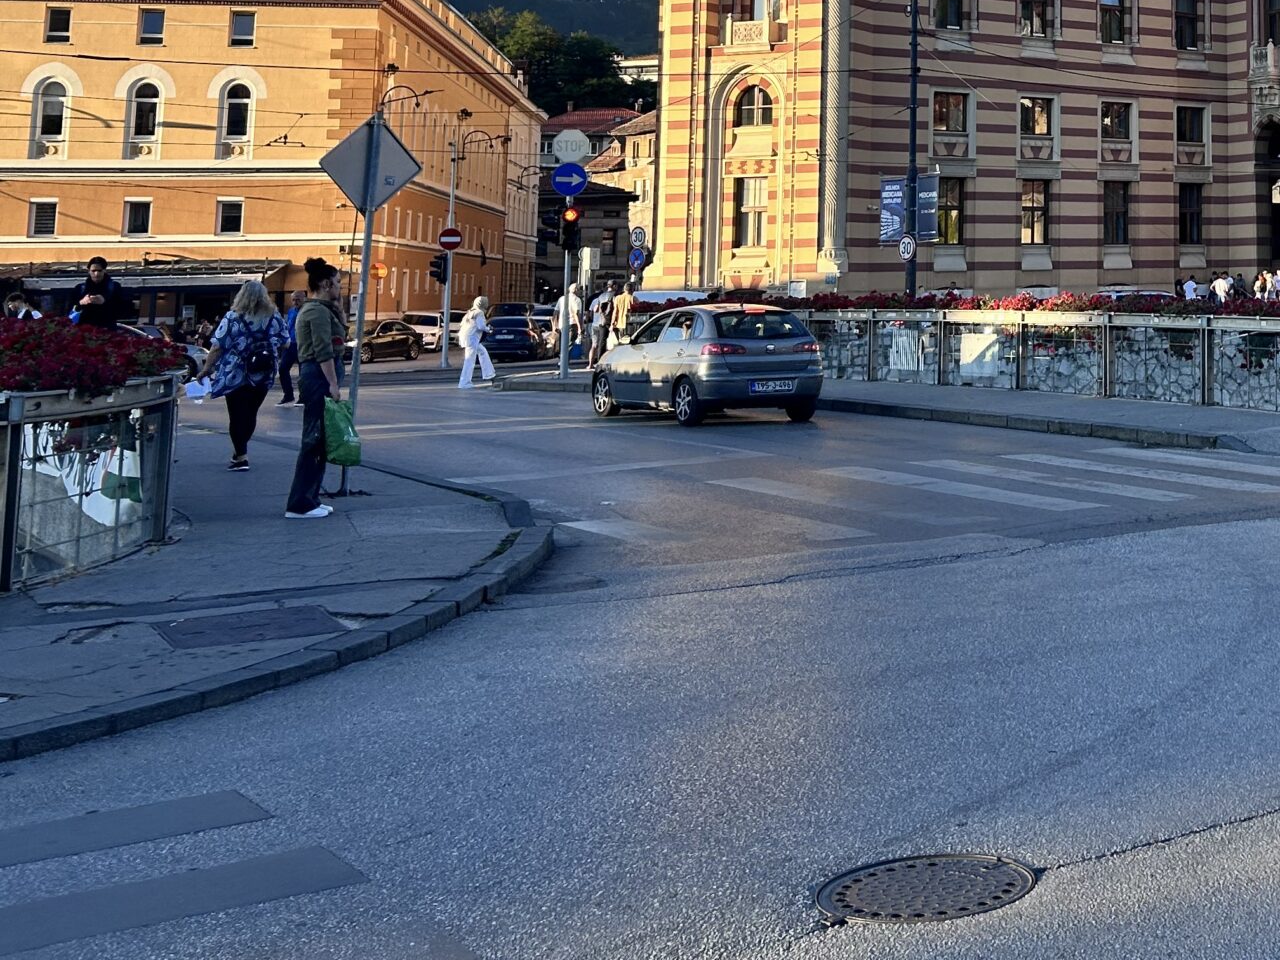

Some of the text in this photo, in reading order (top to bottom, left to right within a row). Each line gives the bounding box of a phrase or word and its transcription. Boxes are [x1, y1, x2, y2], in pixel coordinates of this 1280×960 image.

[556, 140, 586, 152] STOP
[633, 231, 643, 243] 30
[901, 241, 912, 255] 30
